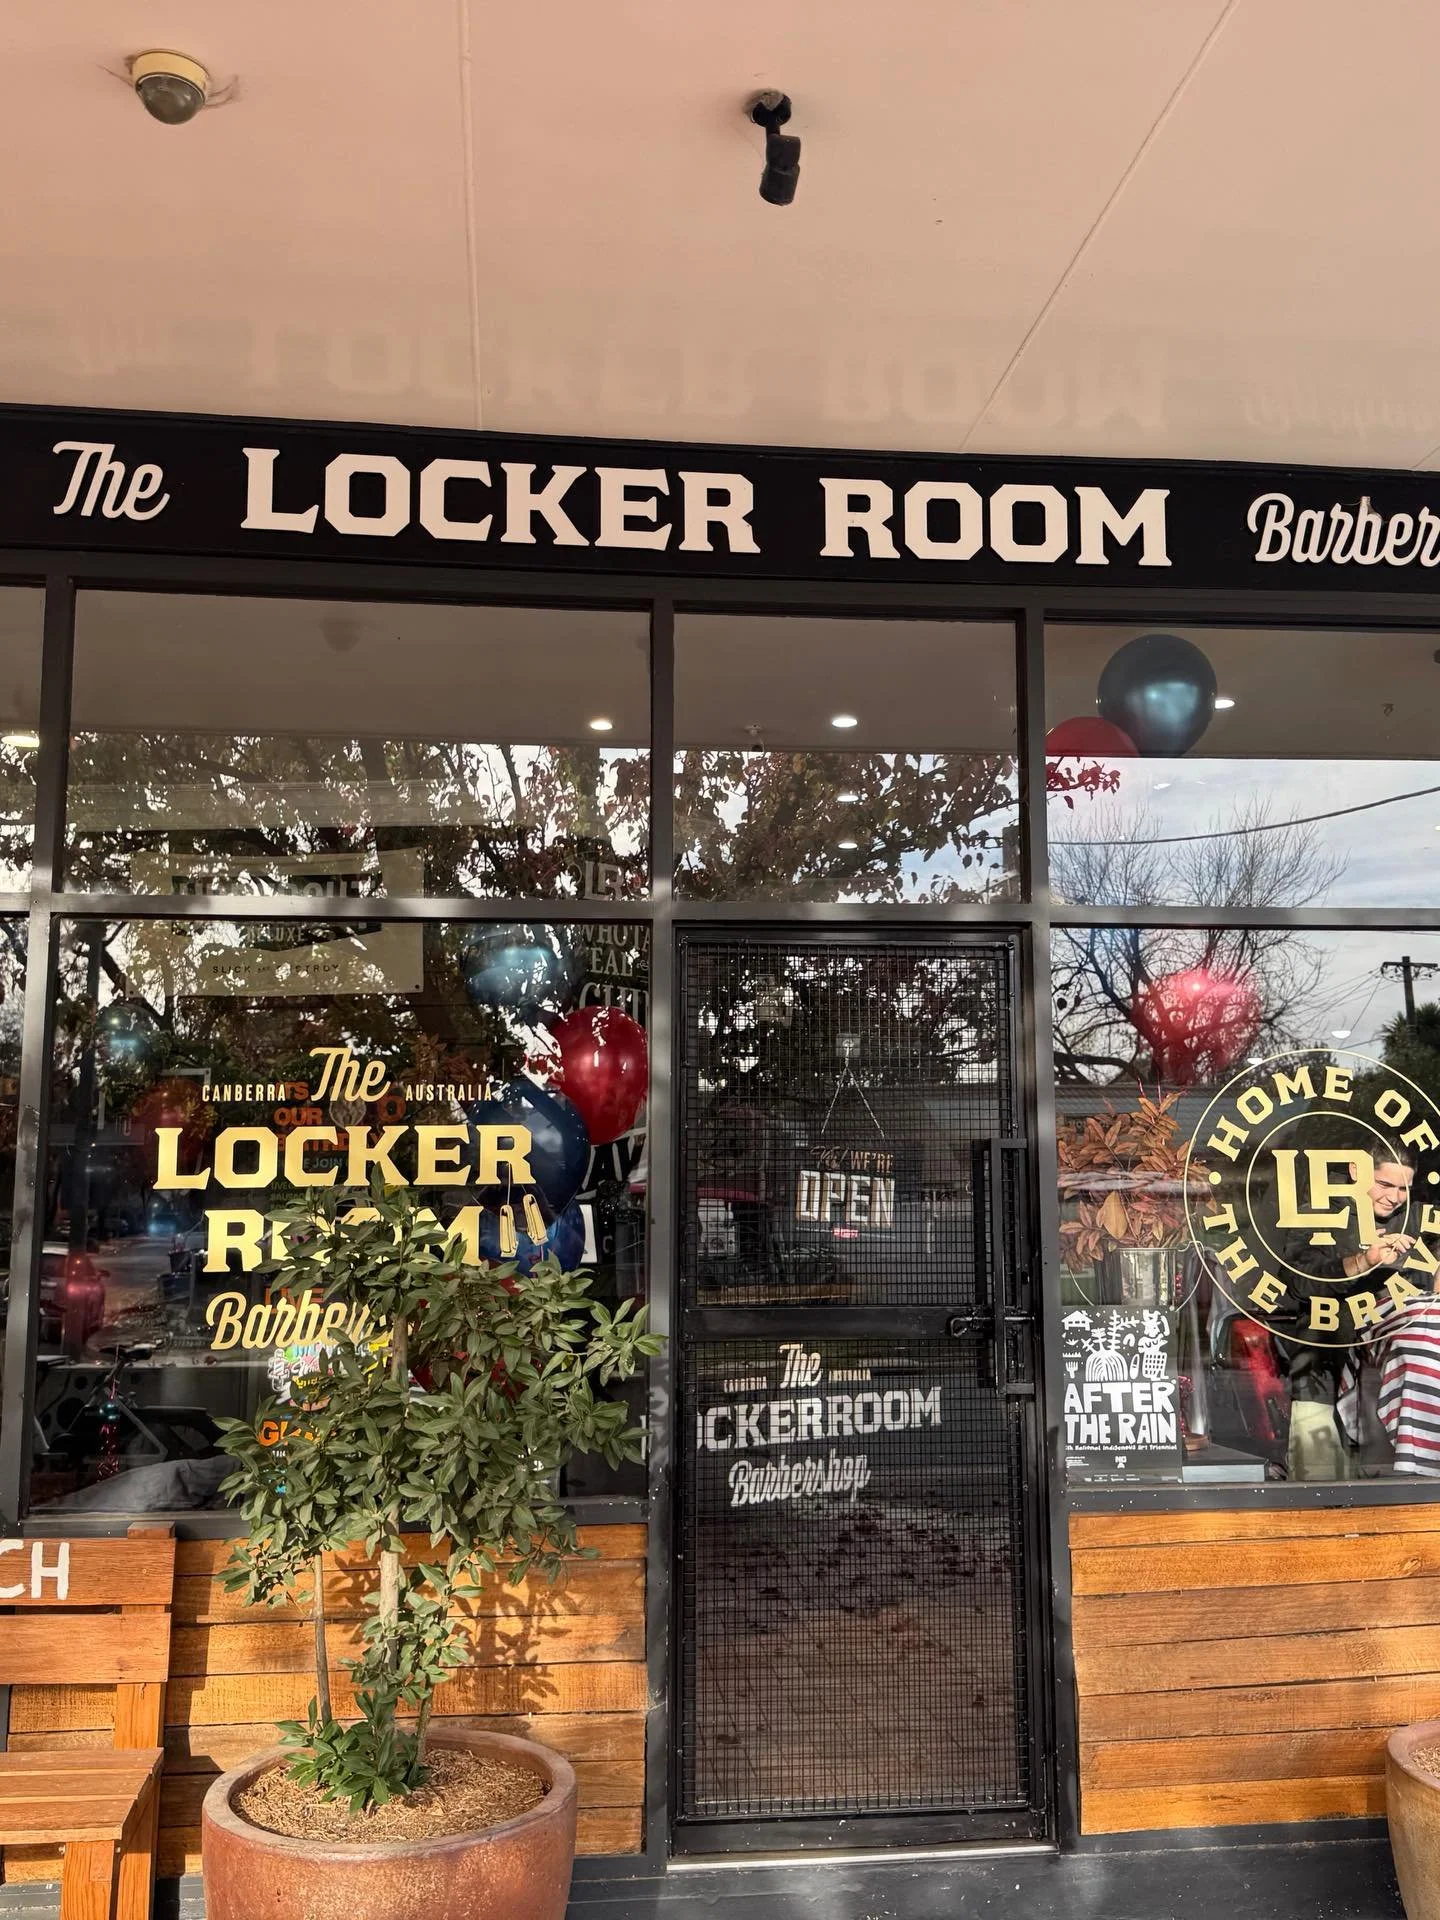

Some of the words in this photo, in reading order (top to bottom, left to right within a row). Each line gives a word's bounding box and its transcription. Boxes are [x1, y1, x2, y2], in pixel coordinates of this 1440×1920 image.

[52, 440, 170, 520] The
[241, 447, 761, 553] LOCKER
[819, 477, 1173, 566] ROOM
[1247, 492, 1440, 567] Barber
[202, 1083, 287, 1102] CANBERRA
[405, 1084, 492, 1102] AUSTRALIA
[309, 1047, 391, 1102] The
[273, 1107, 323, 1126] OUR
[1207, 1066, 1354, 1162] HOME
[1374, 1090, 1440, 1152] OF
[153, 1123, 536, 1190] LOCKER
[796, 1170, 896, 1229] OPEN
[1272, 1150, 1381, 1249] LR
[1203, 1203, 1288, 1314] THE
[779, 1343, 824, 1389] The
[1063, 1382, 1177, 1414] AFTER
[1064, 1413, 1112, 1444] THE
[1117, 1413, 1178, 1444] RAIN
[728, 1447, 872, 1507] Barbershop
